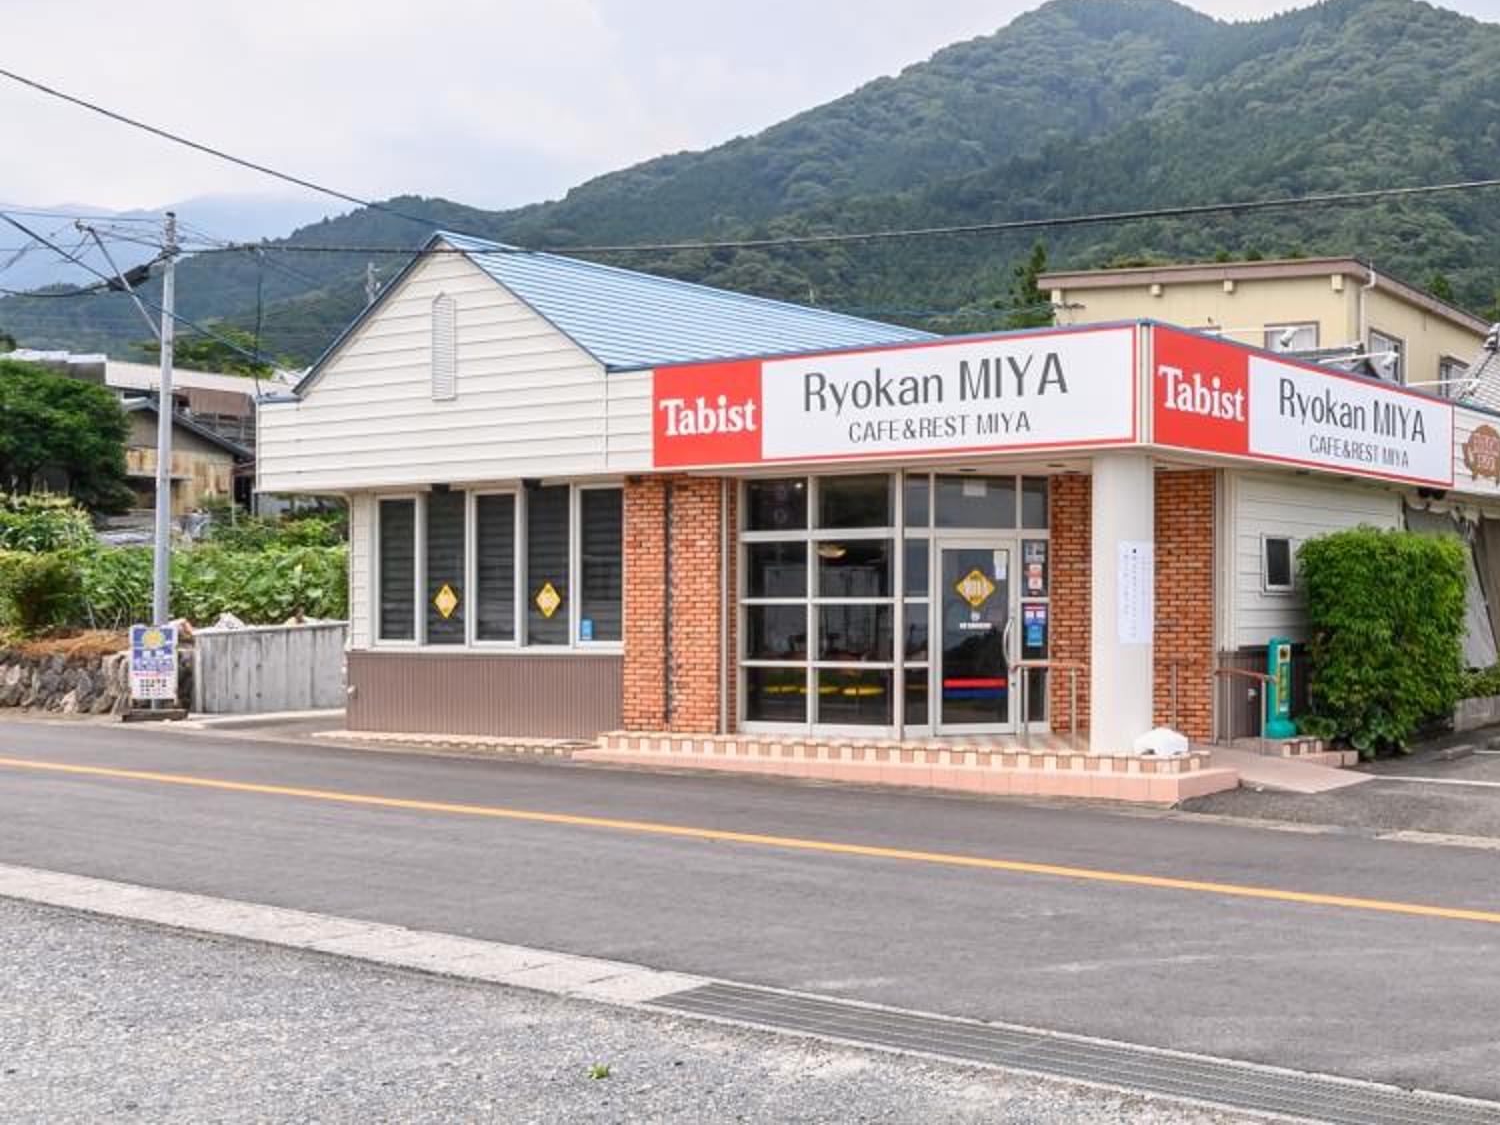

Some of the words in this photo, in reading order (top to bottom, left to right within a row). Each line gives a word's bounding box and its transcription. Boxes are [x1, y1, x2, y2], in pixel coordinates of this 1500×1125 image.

[804, 368, 944, 416] Ryokan
[959, 353, 1068, 401] MIYA
[1158, 365, 1245, 422] Tabist
[660, 395, 757, 437] Tabist
[849, 415, 970, 443] CAFE&REST
[977, 411, 1031, 435] MIYA
[1279, 377, 1365, 431] Ryokan
[1373, 400, 1426, 443] MIYA
[1382, 446, 1409, 469] MIYA
